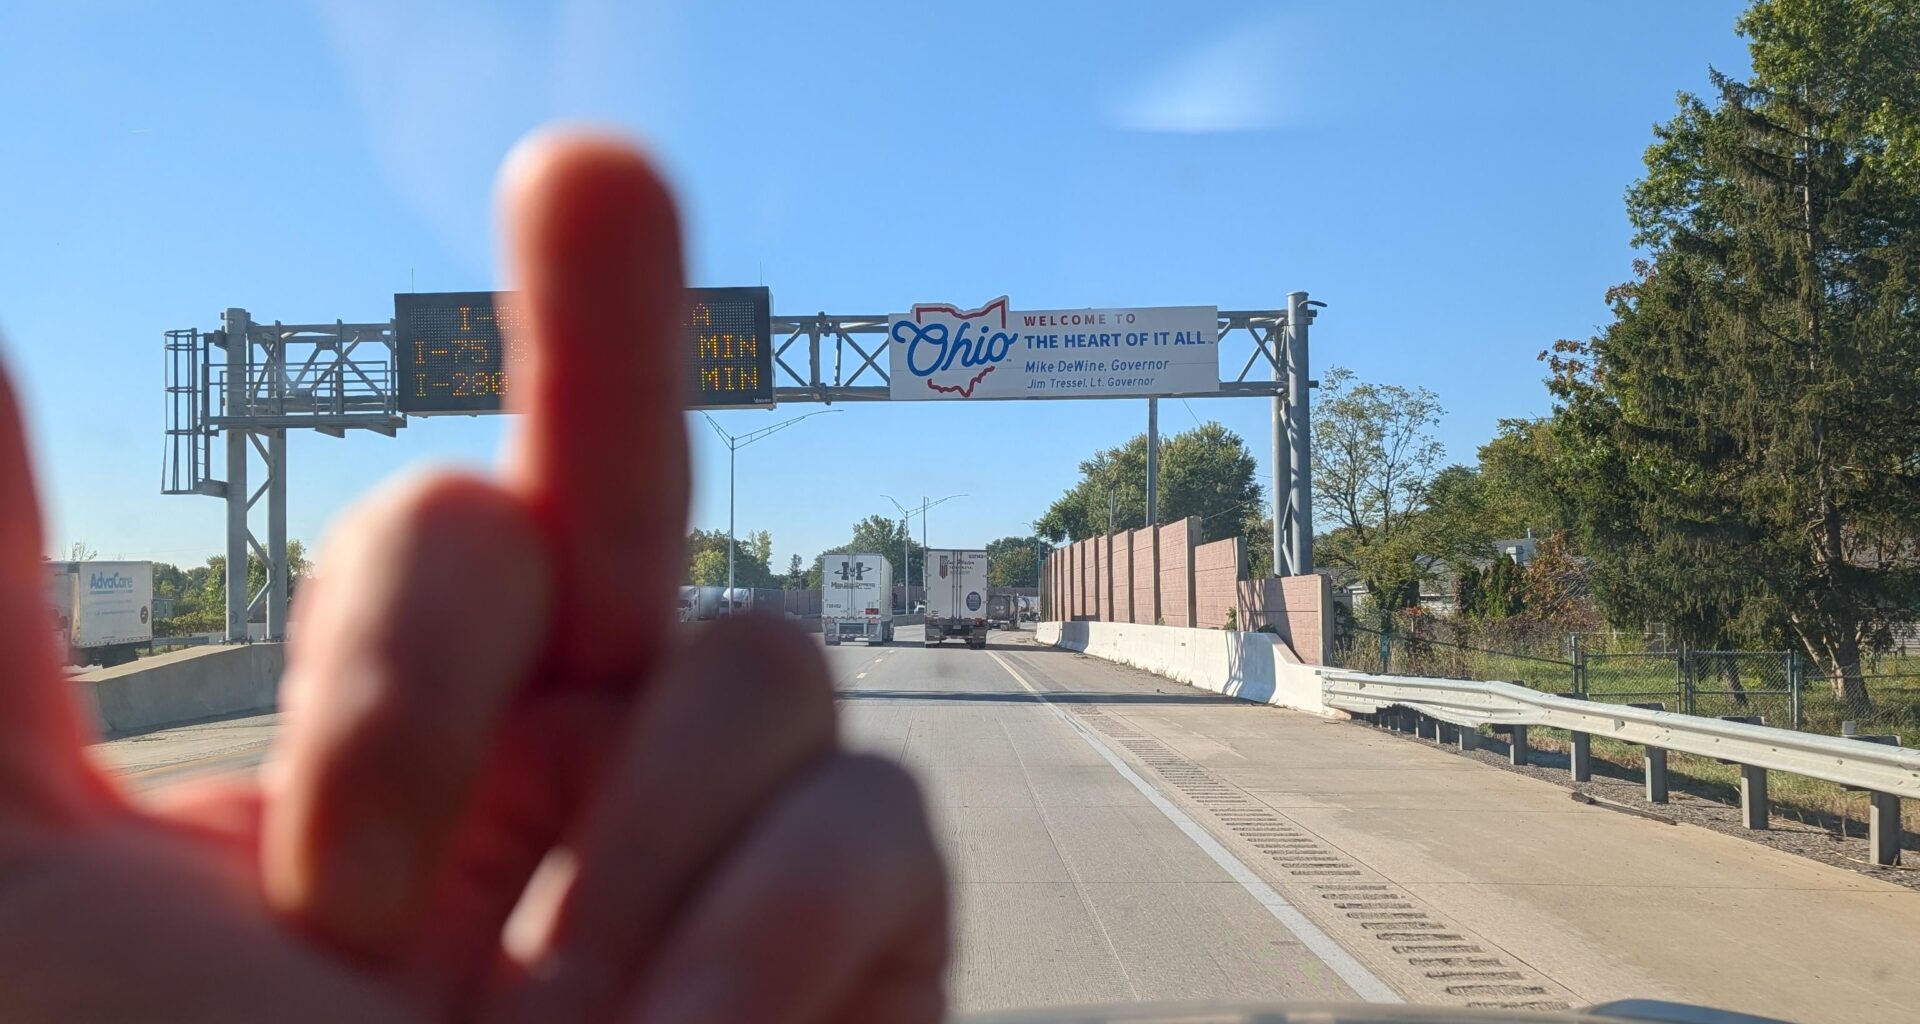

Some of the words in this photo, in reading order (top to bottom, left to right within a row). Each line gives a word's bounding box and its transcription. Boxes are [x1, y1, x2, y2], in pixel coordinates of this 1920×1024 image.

[1023, 313, 1107, 327] WELCOME
[1115, 313, 1136, 325] TO
[414, 338, 489, 364] I-75
[699, 334, 757, 358] MIN
[891, 320, 1019, 377] Ohio
[1023, 334, 1059, 350] THE
[1064, 333, 1122, 348] HEART
[1125, 332, 1149, 347] OF
[1153, 331, 1170, 346] IT
[1174, 330, 1206, 345] ALL
[1025, 360, 1055, 373] Mike
[1111, 359, 1170, 371] Governor
[415, 371, 510, 397] I-280
[701, 367, 758, 391] MIN
[1027, 378, 1046, 389] Jim
[1090, 377, 1105, 387] Lt.
[1107, 377, 1155, 387] Governor
[90, 571, 133, 589] AdvaCare
